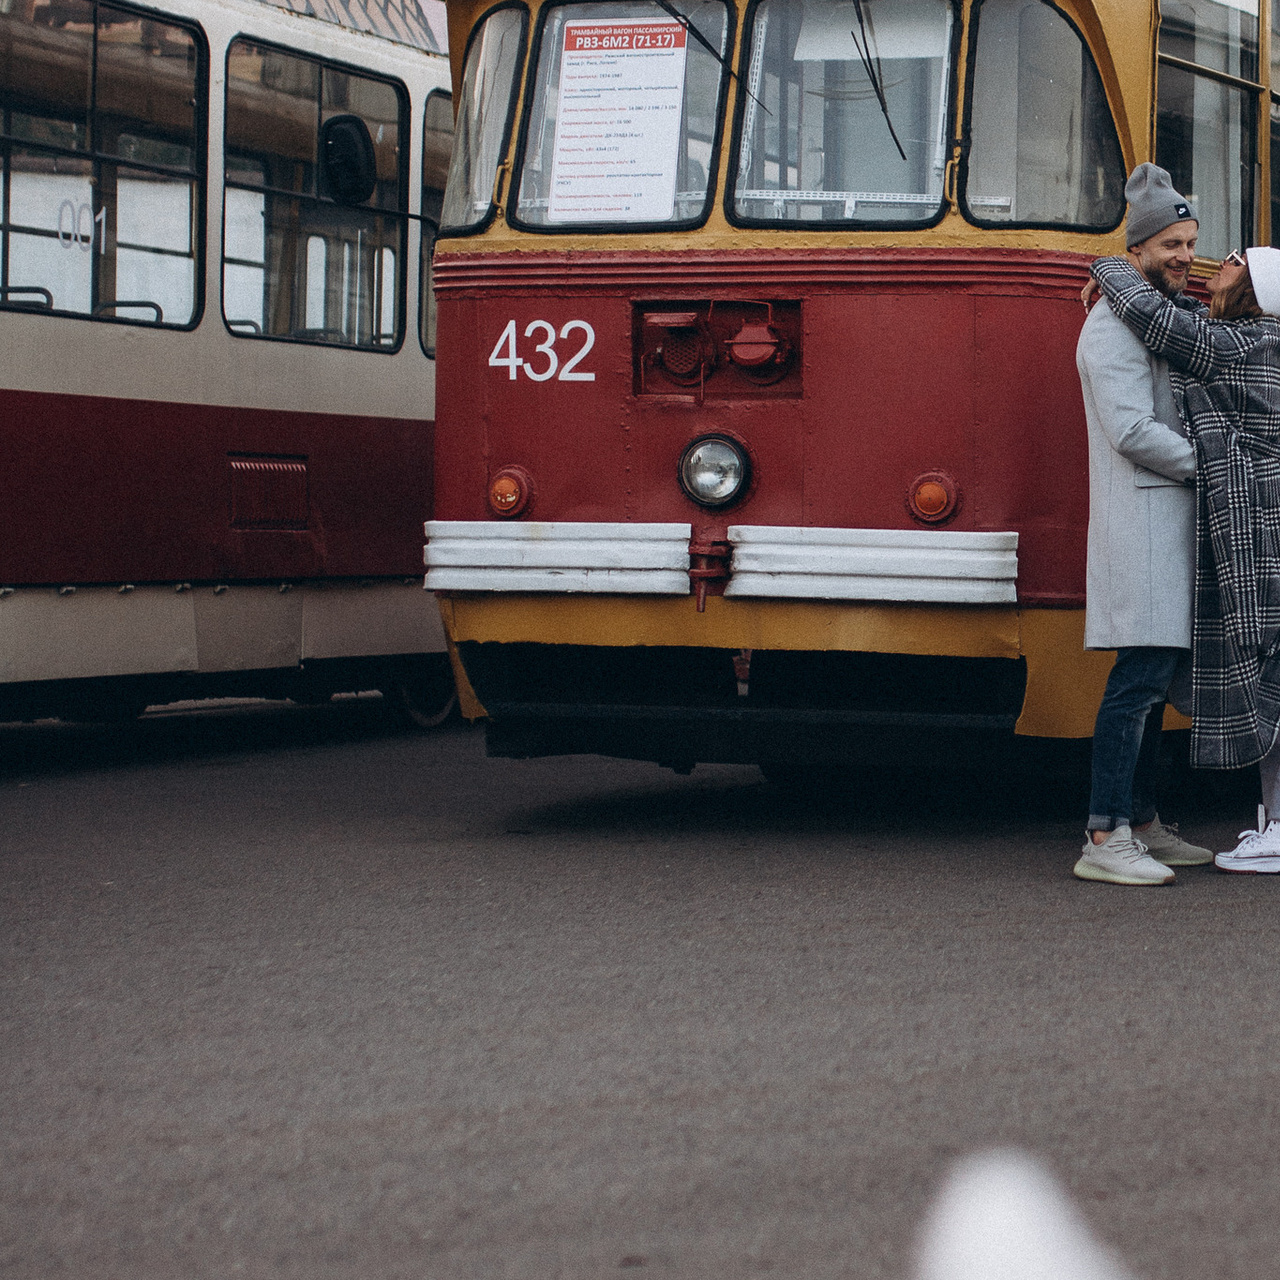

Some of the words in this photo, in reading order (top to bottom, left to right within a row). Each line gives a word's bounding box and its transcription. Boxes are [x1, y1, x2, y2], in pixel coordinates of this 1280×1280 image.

[570, 27, 613, 36] ТРАМВАЙНЫЙ
[613, 27, 633, 35] ВАГОН
[634, 25, 682, 34] ПАССАЖИРСКИЙ
[633, 34, 675, 49] (71-17)
[58, 199, 106, 255] 001
[489, 319, 596, 382] 432
